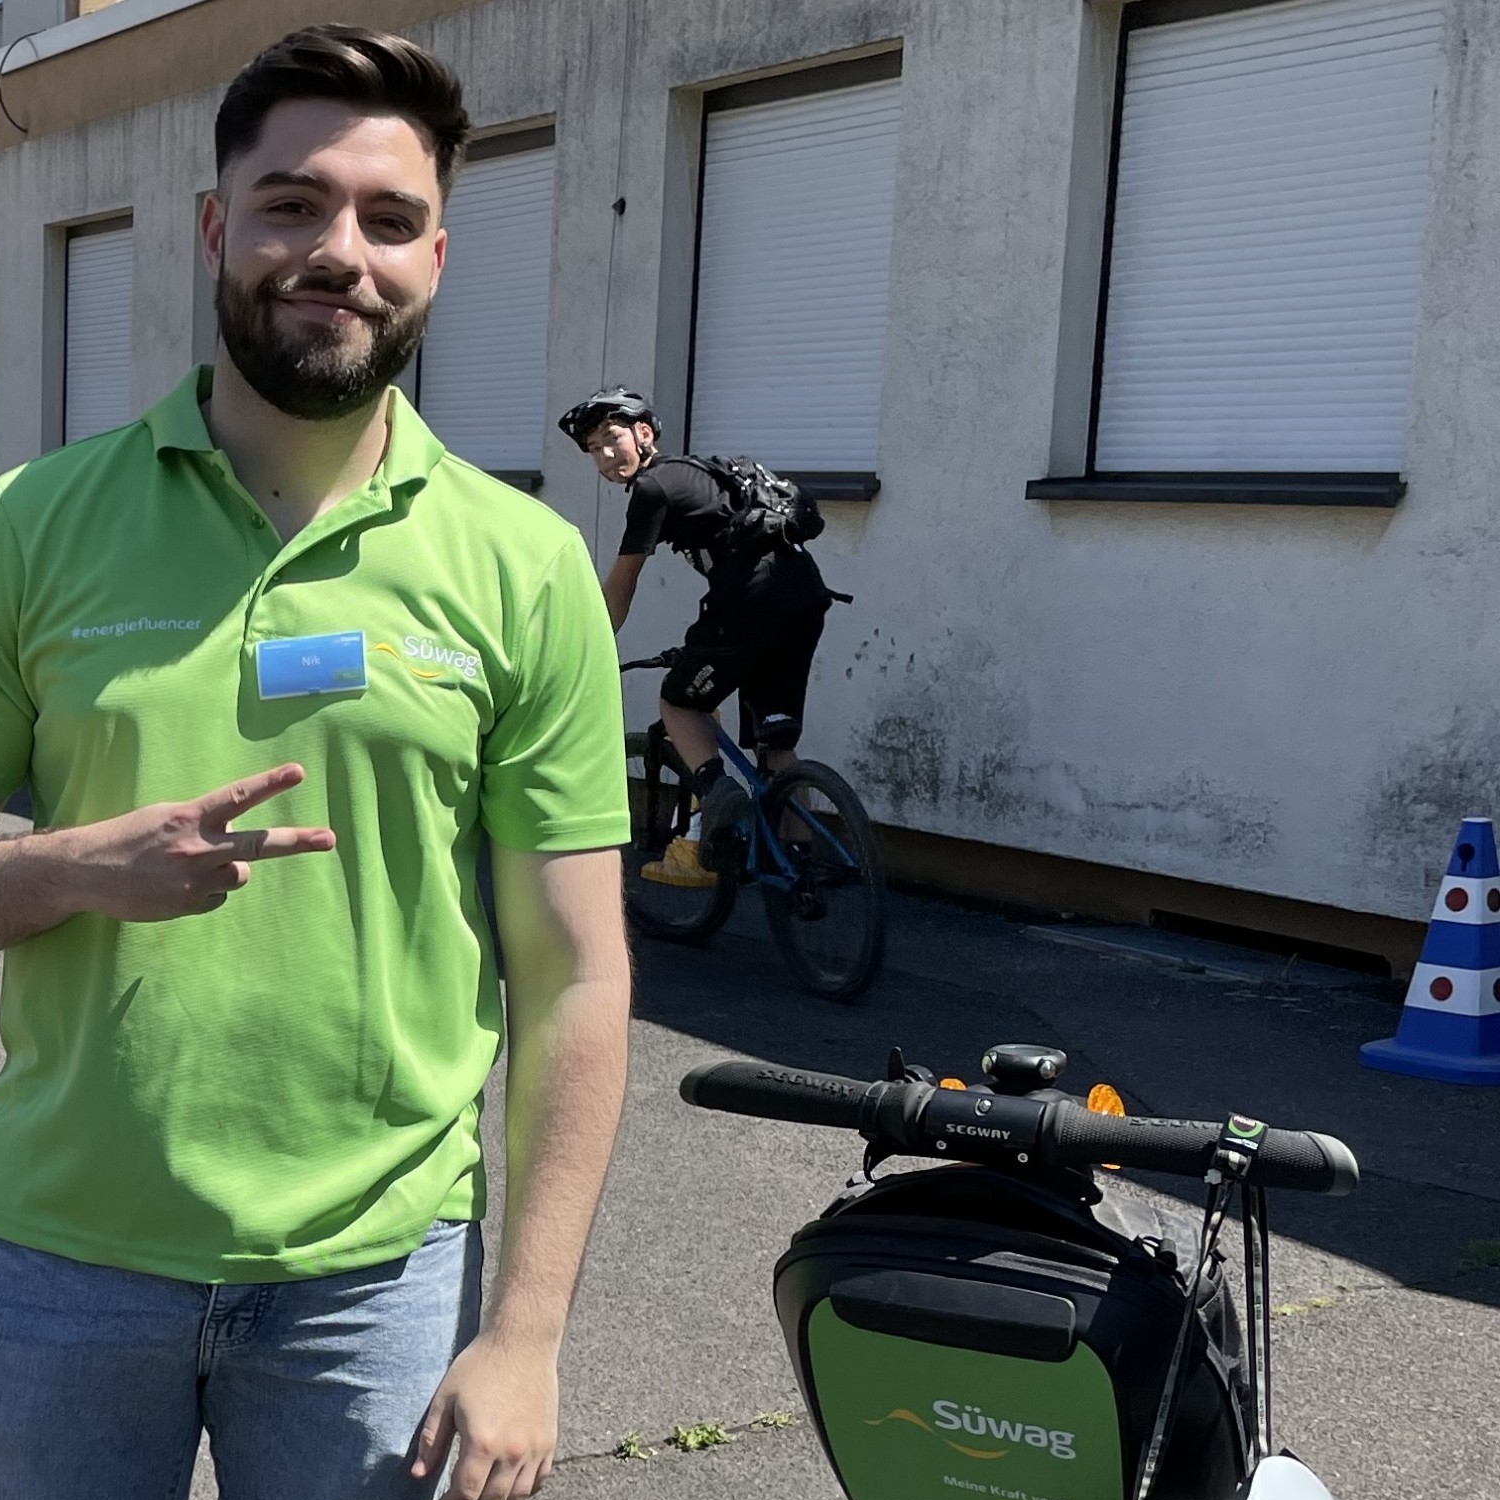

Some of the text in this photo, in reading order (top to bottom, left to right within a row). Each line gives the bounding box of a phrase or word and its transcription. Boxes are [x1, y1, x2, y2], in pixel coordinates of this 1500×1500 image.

[71, 616, 201, 639] #energiefluencer
[301, 655, 321, 667] Nik
[404, 635, 480, 677] Süwag
[945, 1123, 1012, 1141] SEGWAY
[932, 1400, 1077, 1460] Süwag
[943, 1475, 987, 1493] Meine
